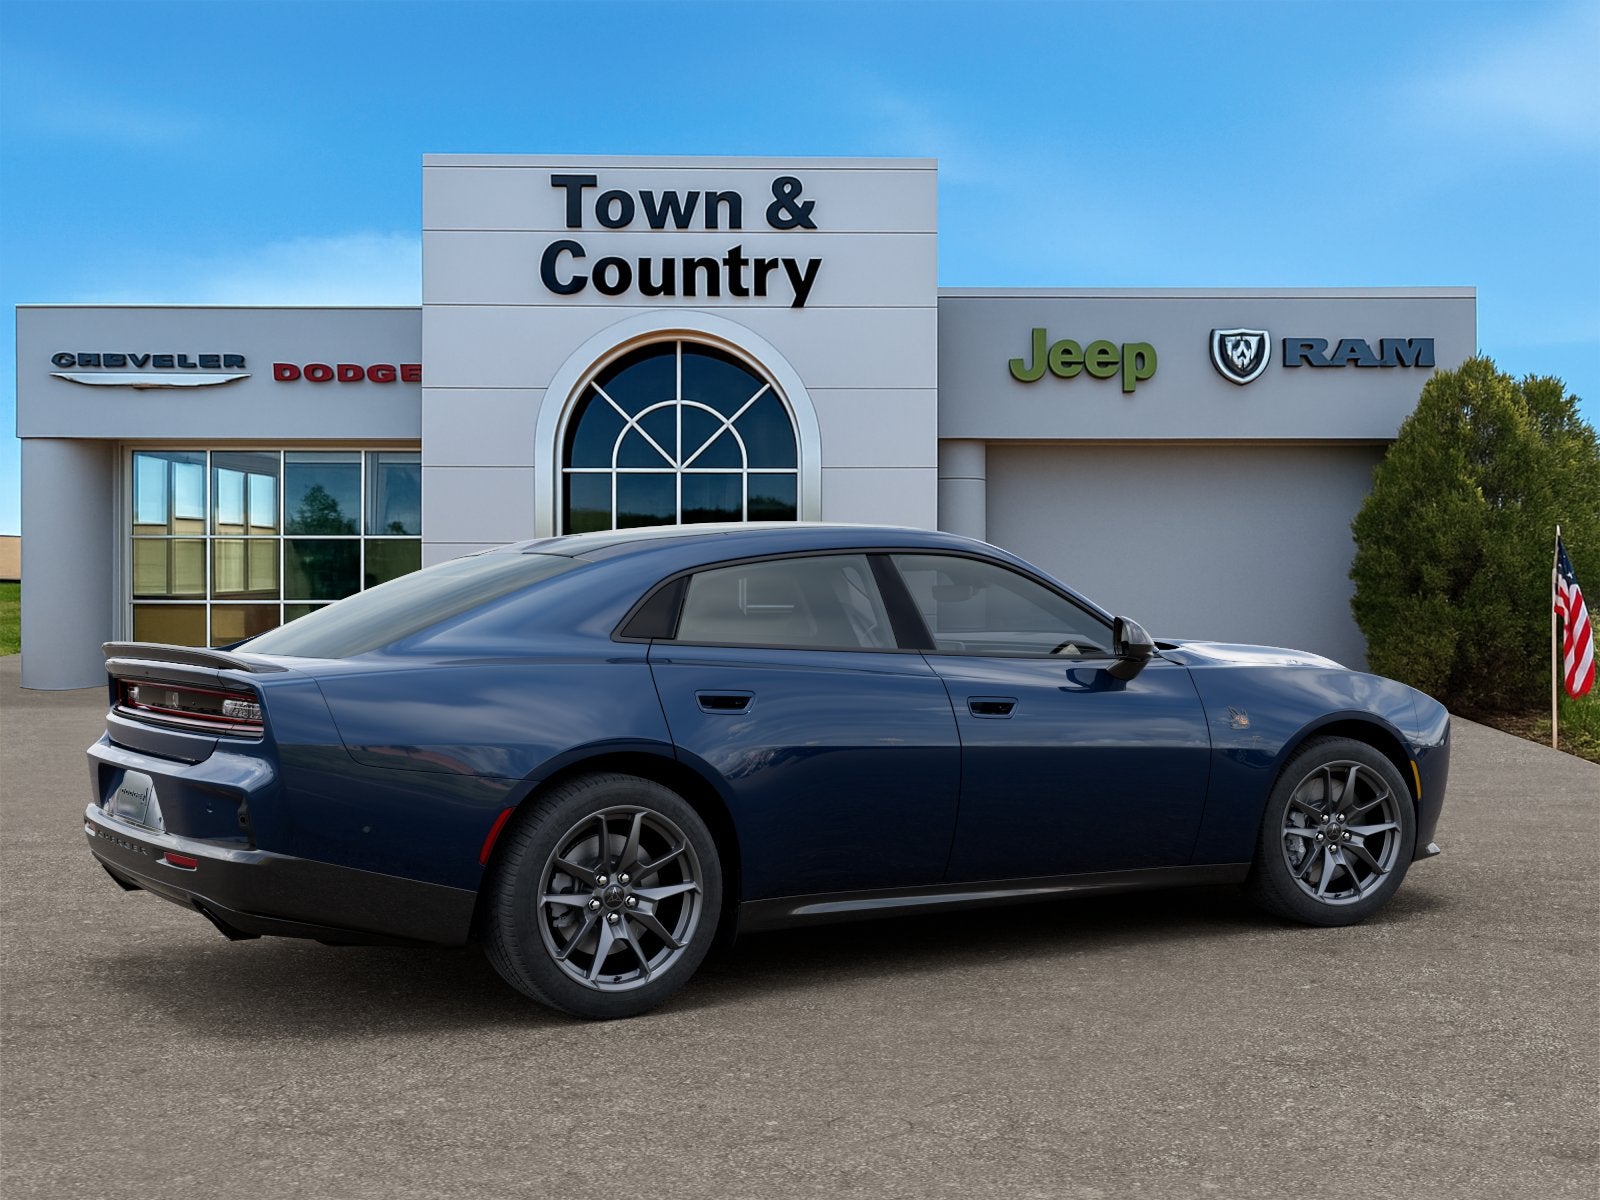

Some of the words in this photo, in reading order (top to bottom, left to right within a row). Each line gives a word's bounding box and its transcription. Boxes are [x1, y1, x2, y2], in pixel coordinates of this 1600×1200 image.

[550, 174, 742, 229] Town
[766, 176, 817, 230] &
[540, 239, 822, 308] Country
[273, 363, 422, 383] DODGE
[1009, 328, 1157, 392] Jeep
[1282, 338, 1435, 367] RAM
